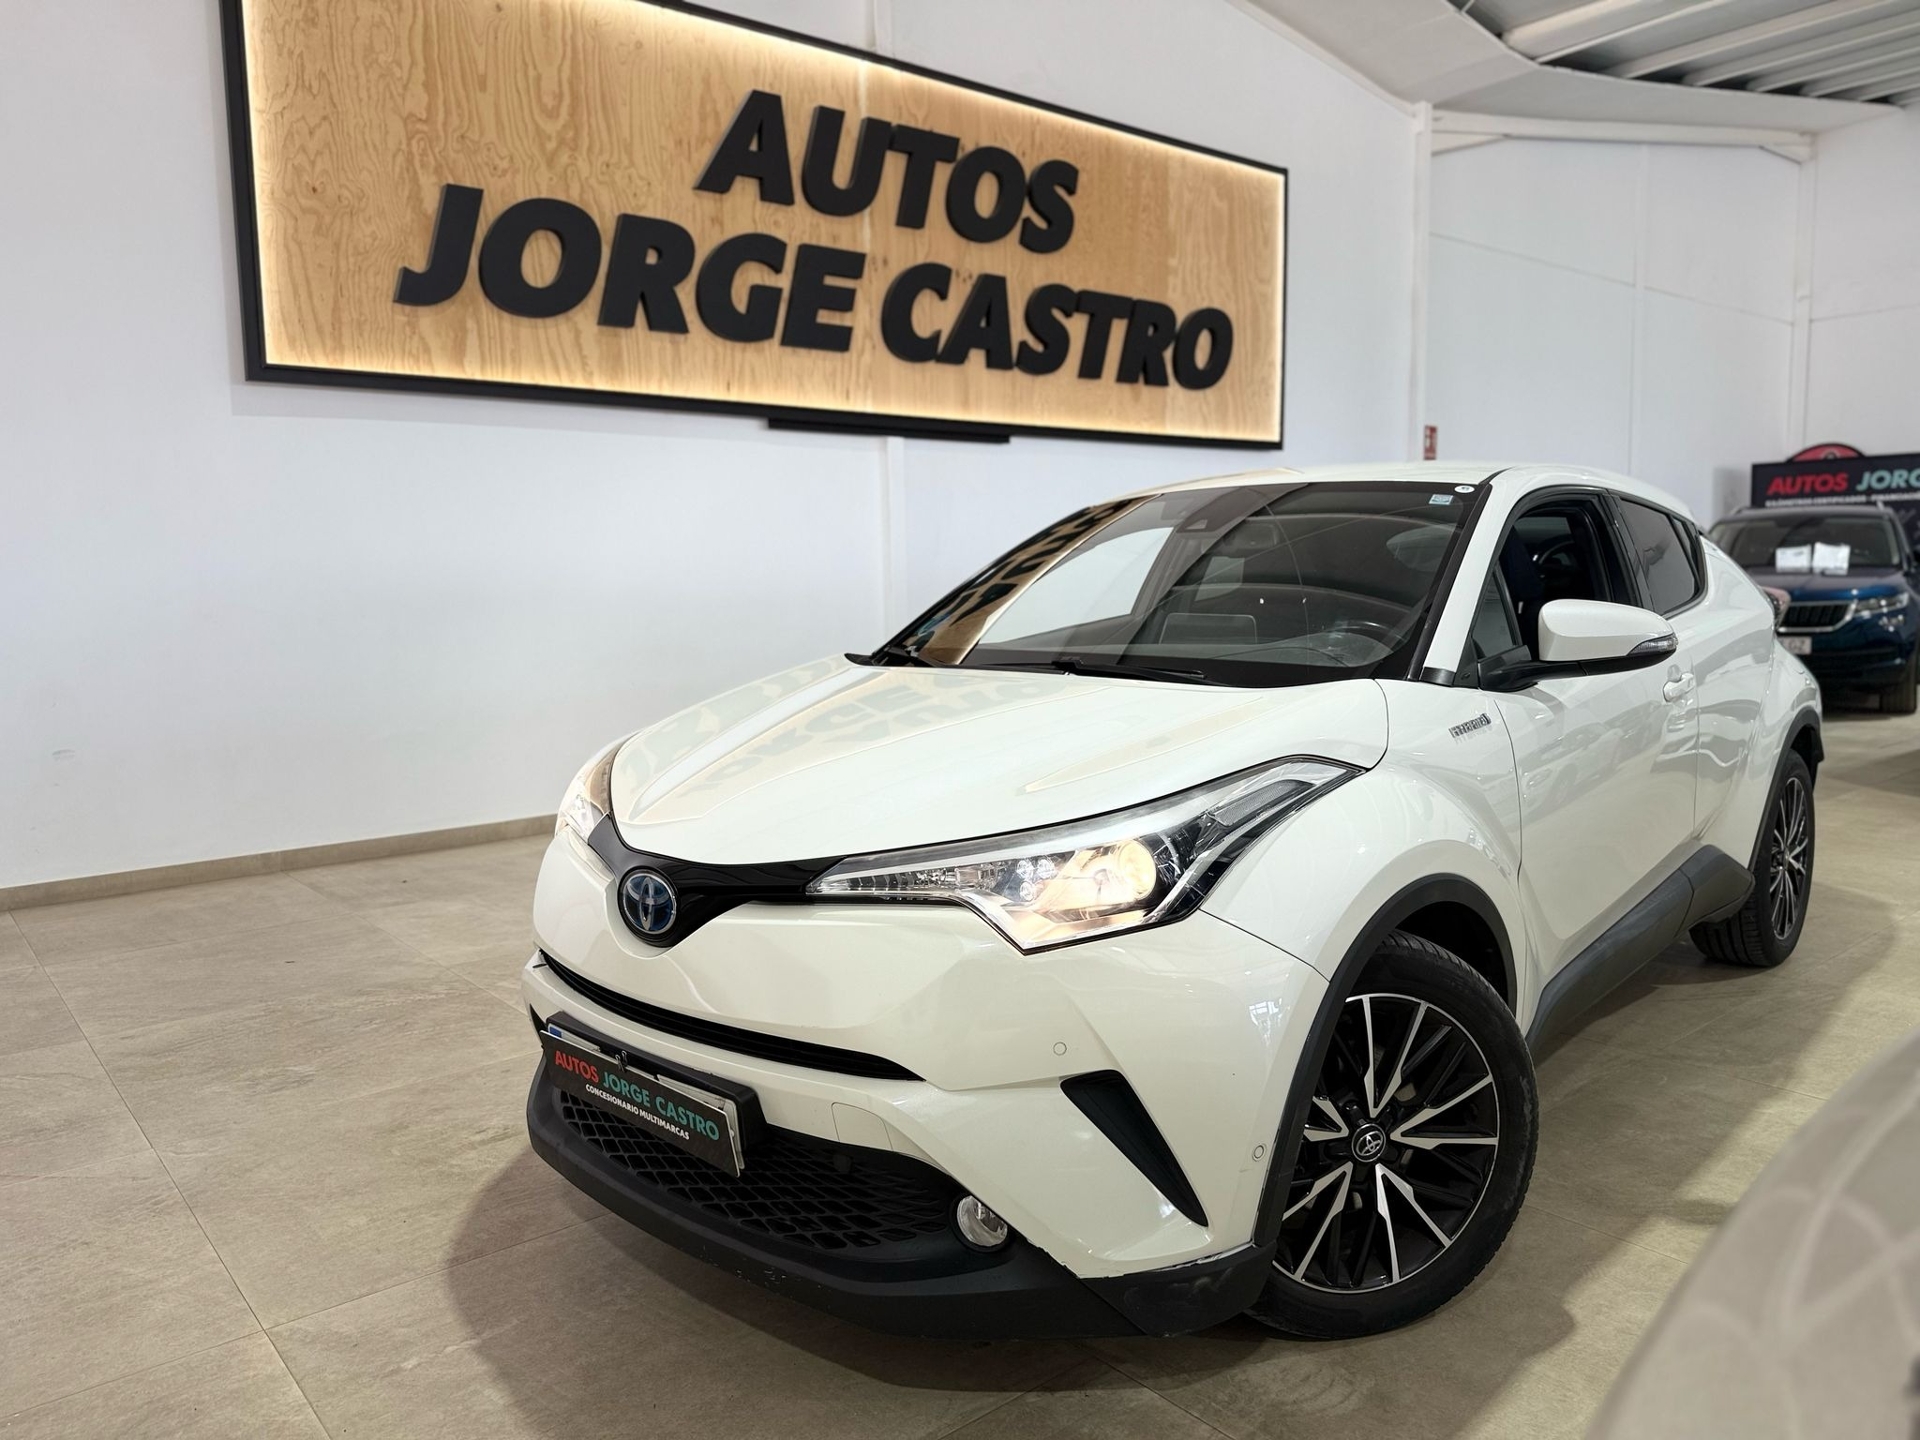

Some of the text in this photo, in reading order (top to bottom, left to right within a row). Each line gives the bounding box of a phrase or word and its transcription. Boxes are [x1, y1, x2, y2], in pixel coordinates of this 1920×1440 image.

[693, 88, 1079, 254] AUTOS
[394, 183, 1234, 391] JORGE CASTRO
[1767, 472, 1848, 495] AUTOS
[555, 1050, 720, 1140] AUTOS JORGE CASTRO
[585, 1083, 690, 1140] CONCESIONARIO MULTIMARCAS
